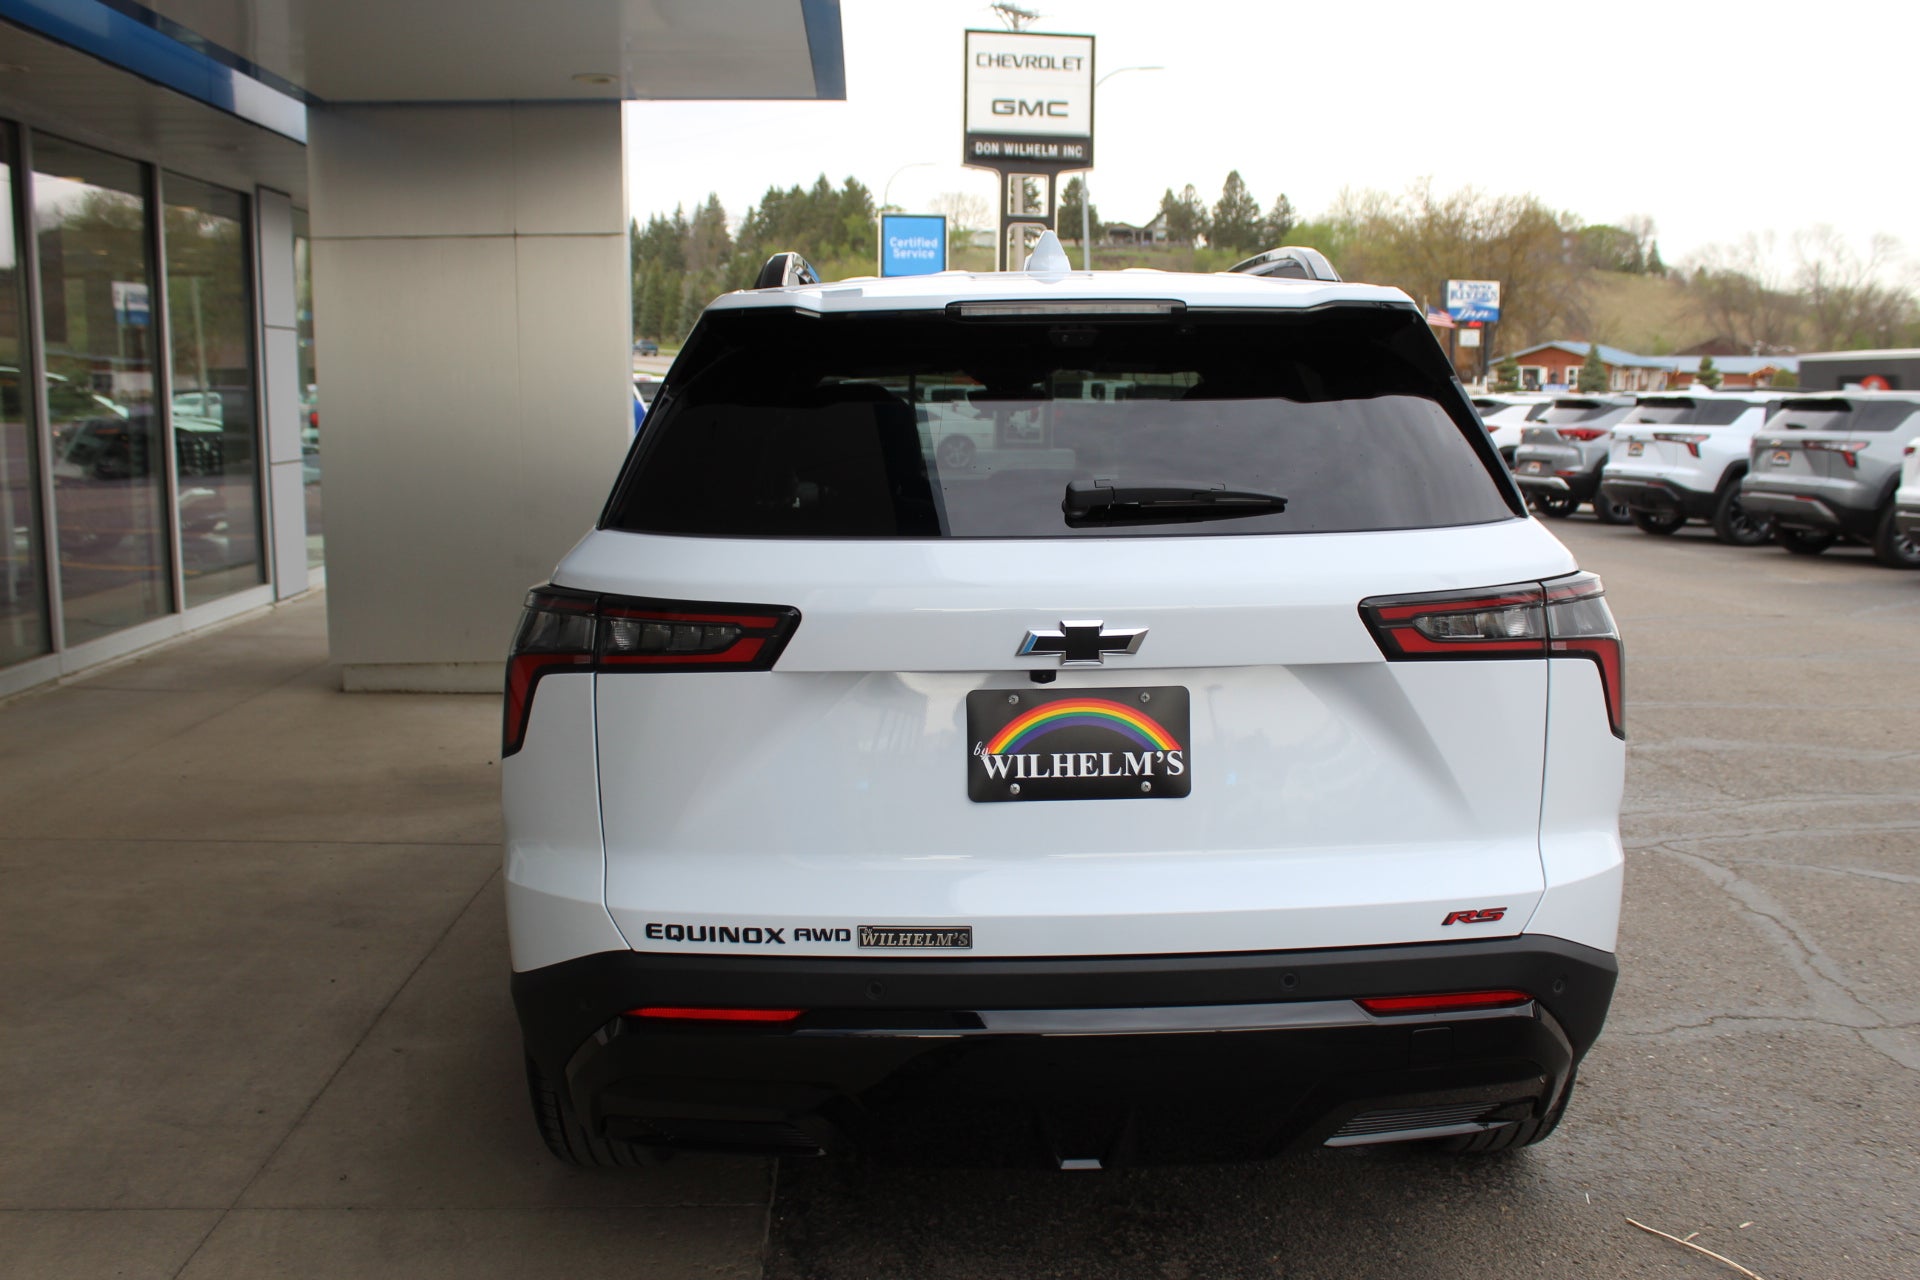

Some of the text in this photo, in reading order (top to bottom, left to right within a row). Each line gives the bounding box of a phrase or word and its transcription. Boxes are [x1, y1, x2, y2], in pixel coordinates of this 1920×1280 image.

[976, 52, 1084, 71] CHEVROLET
[991, 98, 1069, 118] GMC
[975, 141, 1083, 158] DON WILHELM INC
[889, 237, 938, 248] Certified
[893, 247, 935, 259] Service
[973, 741, 991, 760] by
[980, 750, 1185, 780] WILHELM'S
[1441, 906, 1508, 926] RS
[645, 922, 852, 945] EQUINOX AWD
[861, 932, 969, 946] WILHELM'S
